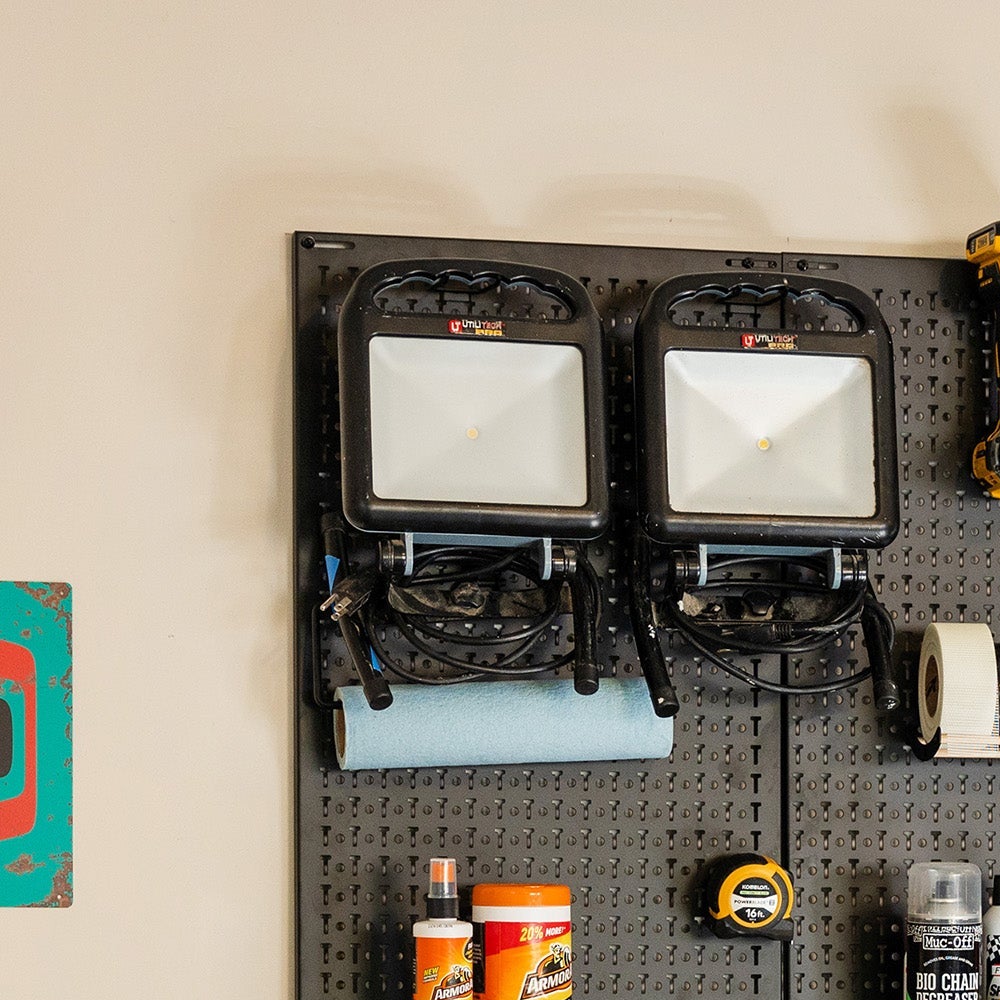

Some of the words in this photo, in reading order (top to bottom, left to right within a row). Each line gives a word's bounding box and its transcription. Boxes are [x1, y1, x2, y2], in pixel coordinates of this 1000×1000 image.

[745, 908, 757, 918] 16
[519, 926, 544, 942] 20%
[925, 936, 972, 948] Muc-Off
[424, 967, 439, 977] NEW
[916, 972, 937, 990] BIO
[941, 972, 979, 991] CHAIN
